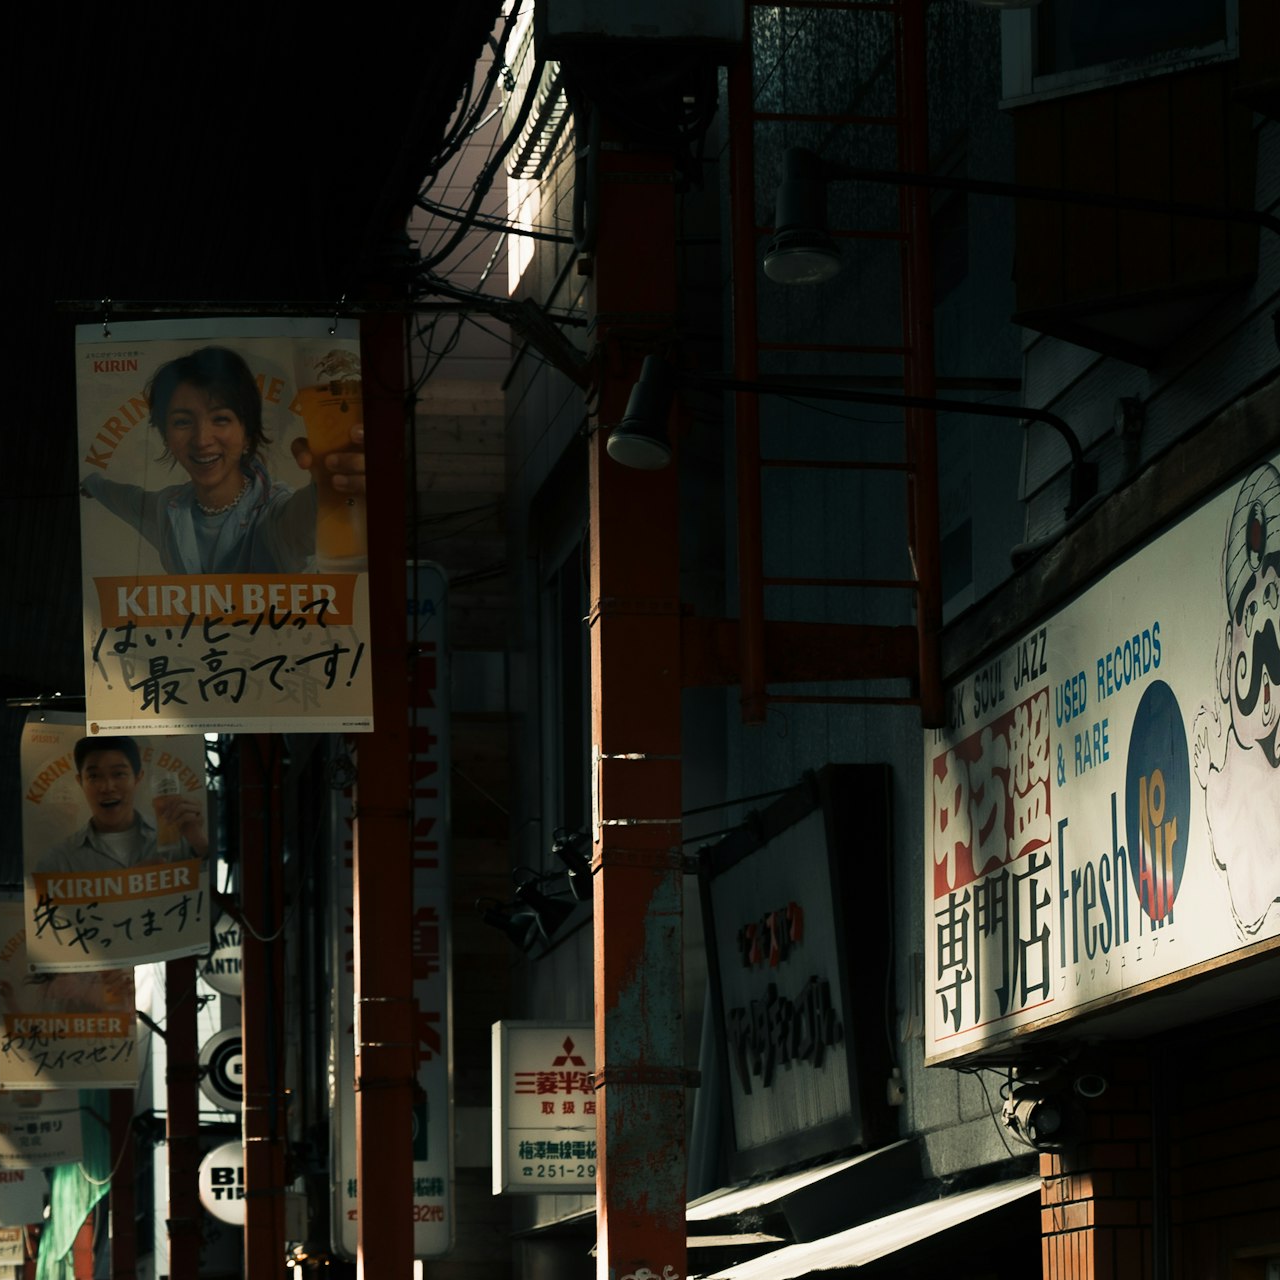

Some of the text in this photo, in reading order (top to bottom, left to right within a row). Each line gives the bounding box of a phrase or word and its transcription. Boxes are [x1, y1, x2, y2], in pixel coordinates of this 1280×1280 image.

[93, 360, 138, 373] KIRIN
[117, 584, 340, 617] KIRIN BEER
[973, 660, 1005, 719] SOUL
[1014, 627, 1048, 691] JAZZ
[1055, 620, 1162, 728] USED RECORDS
[1056, 718, 1110, 788] & RARE
[47, 867, 191, 900] KIRIN BEER
[1057, 791, 1130, 969] Fresh
[935, 852, 1052, 1034] 専門店
[1060, 937, 1176, 991] フレッシュエアー
[13, 1017, 122, 1034] KIRIN BEER
